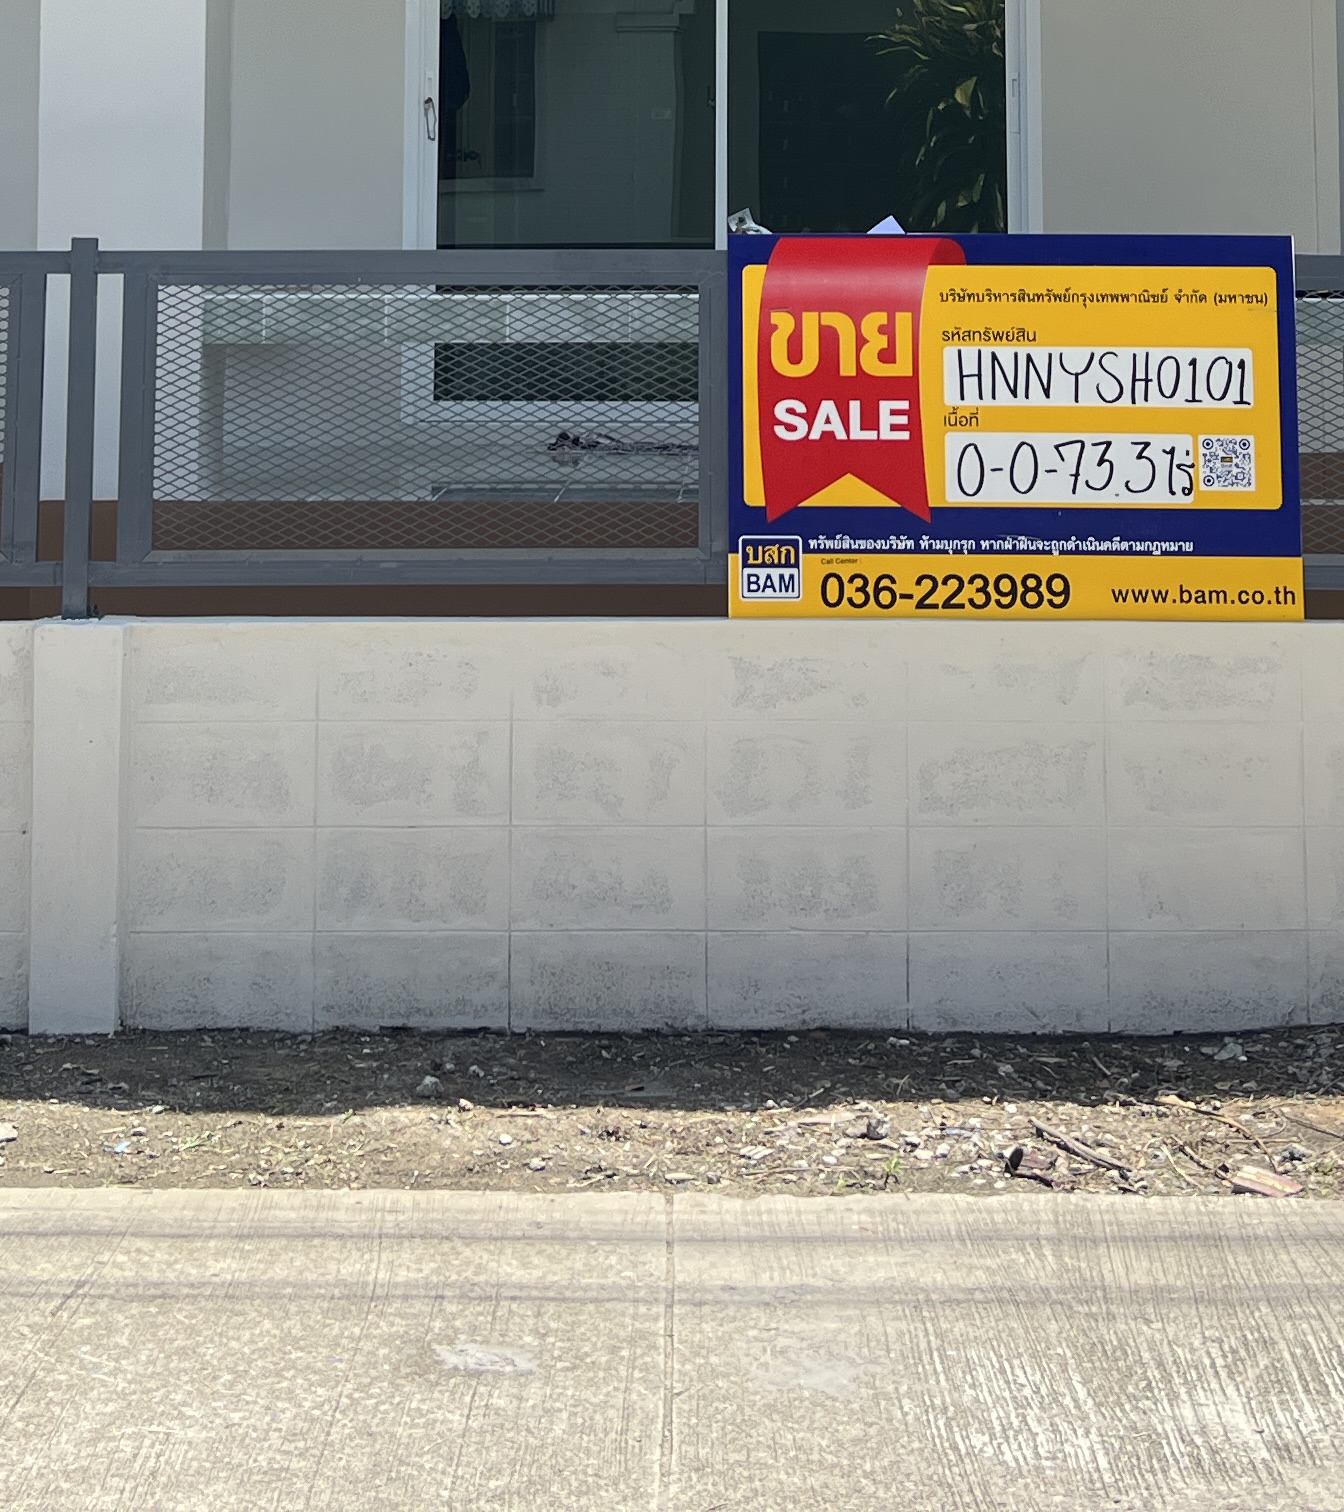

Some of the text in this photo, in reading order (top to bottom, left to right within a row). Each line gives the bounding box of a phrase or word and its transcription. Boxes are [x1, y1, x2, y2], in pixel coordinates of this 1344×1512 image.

[1174, 289, 1207, 304] จำกัด
[1213, 292, 1268, 306] (มหาชน)
[770, 311, 913, 378] ขาย
[941, 326, 1037, 343] รหัสทรัพย์สิน
[957, 349, 1251, 405] HNNYSH0101
[773, 399, 910, 441] SALE
[943, 406, 979, 427] เนื้อที่
[746, 544, 795, 565] บสก
[808, 536, 915, 550] ทรัพย์สินของบริษัท
[919, 535, 975, 555] ห้ามบุกรุก
[747, 574, 795, 593] BAM
[820, 573, 1071, 610] 036-223989
[1111, 584, 1296, 606] www.bam.co.th
